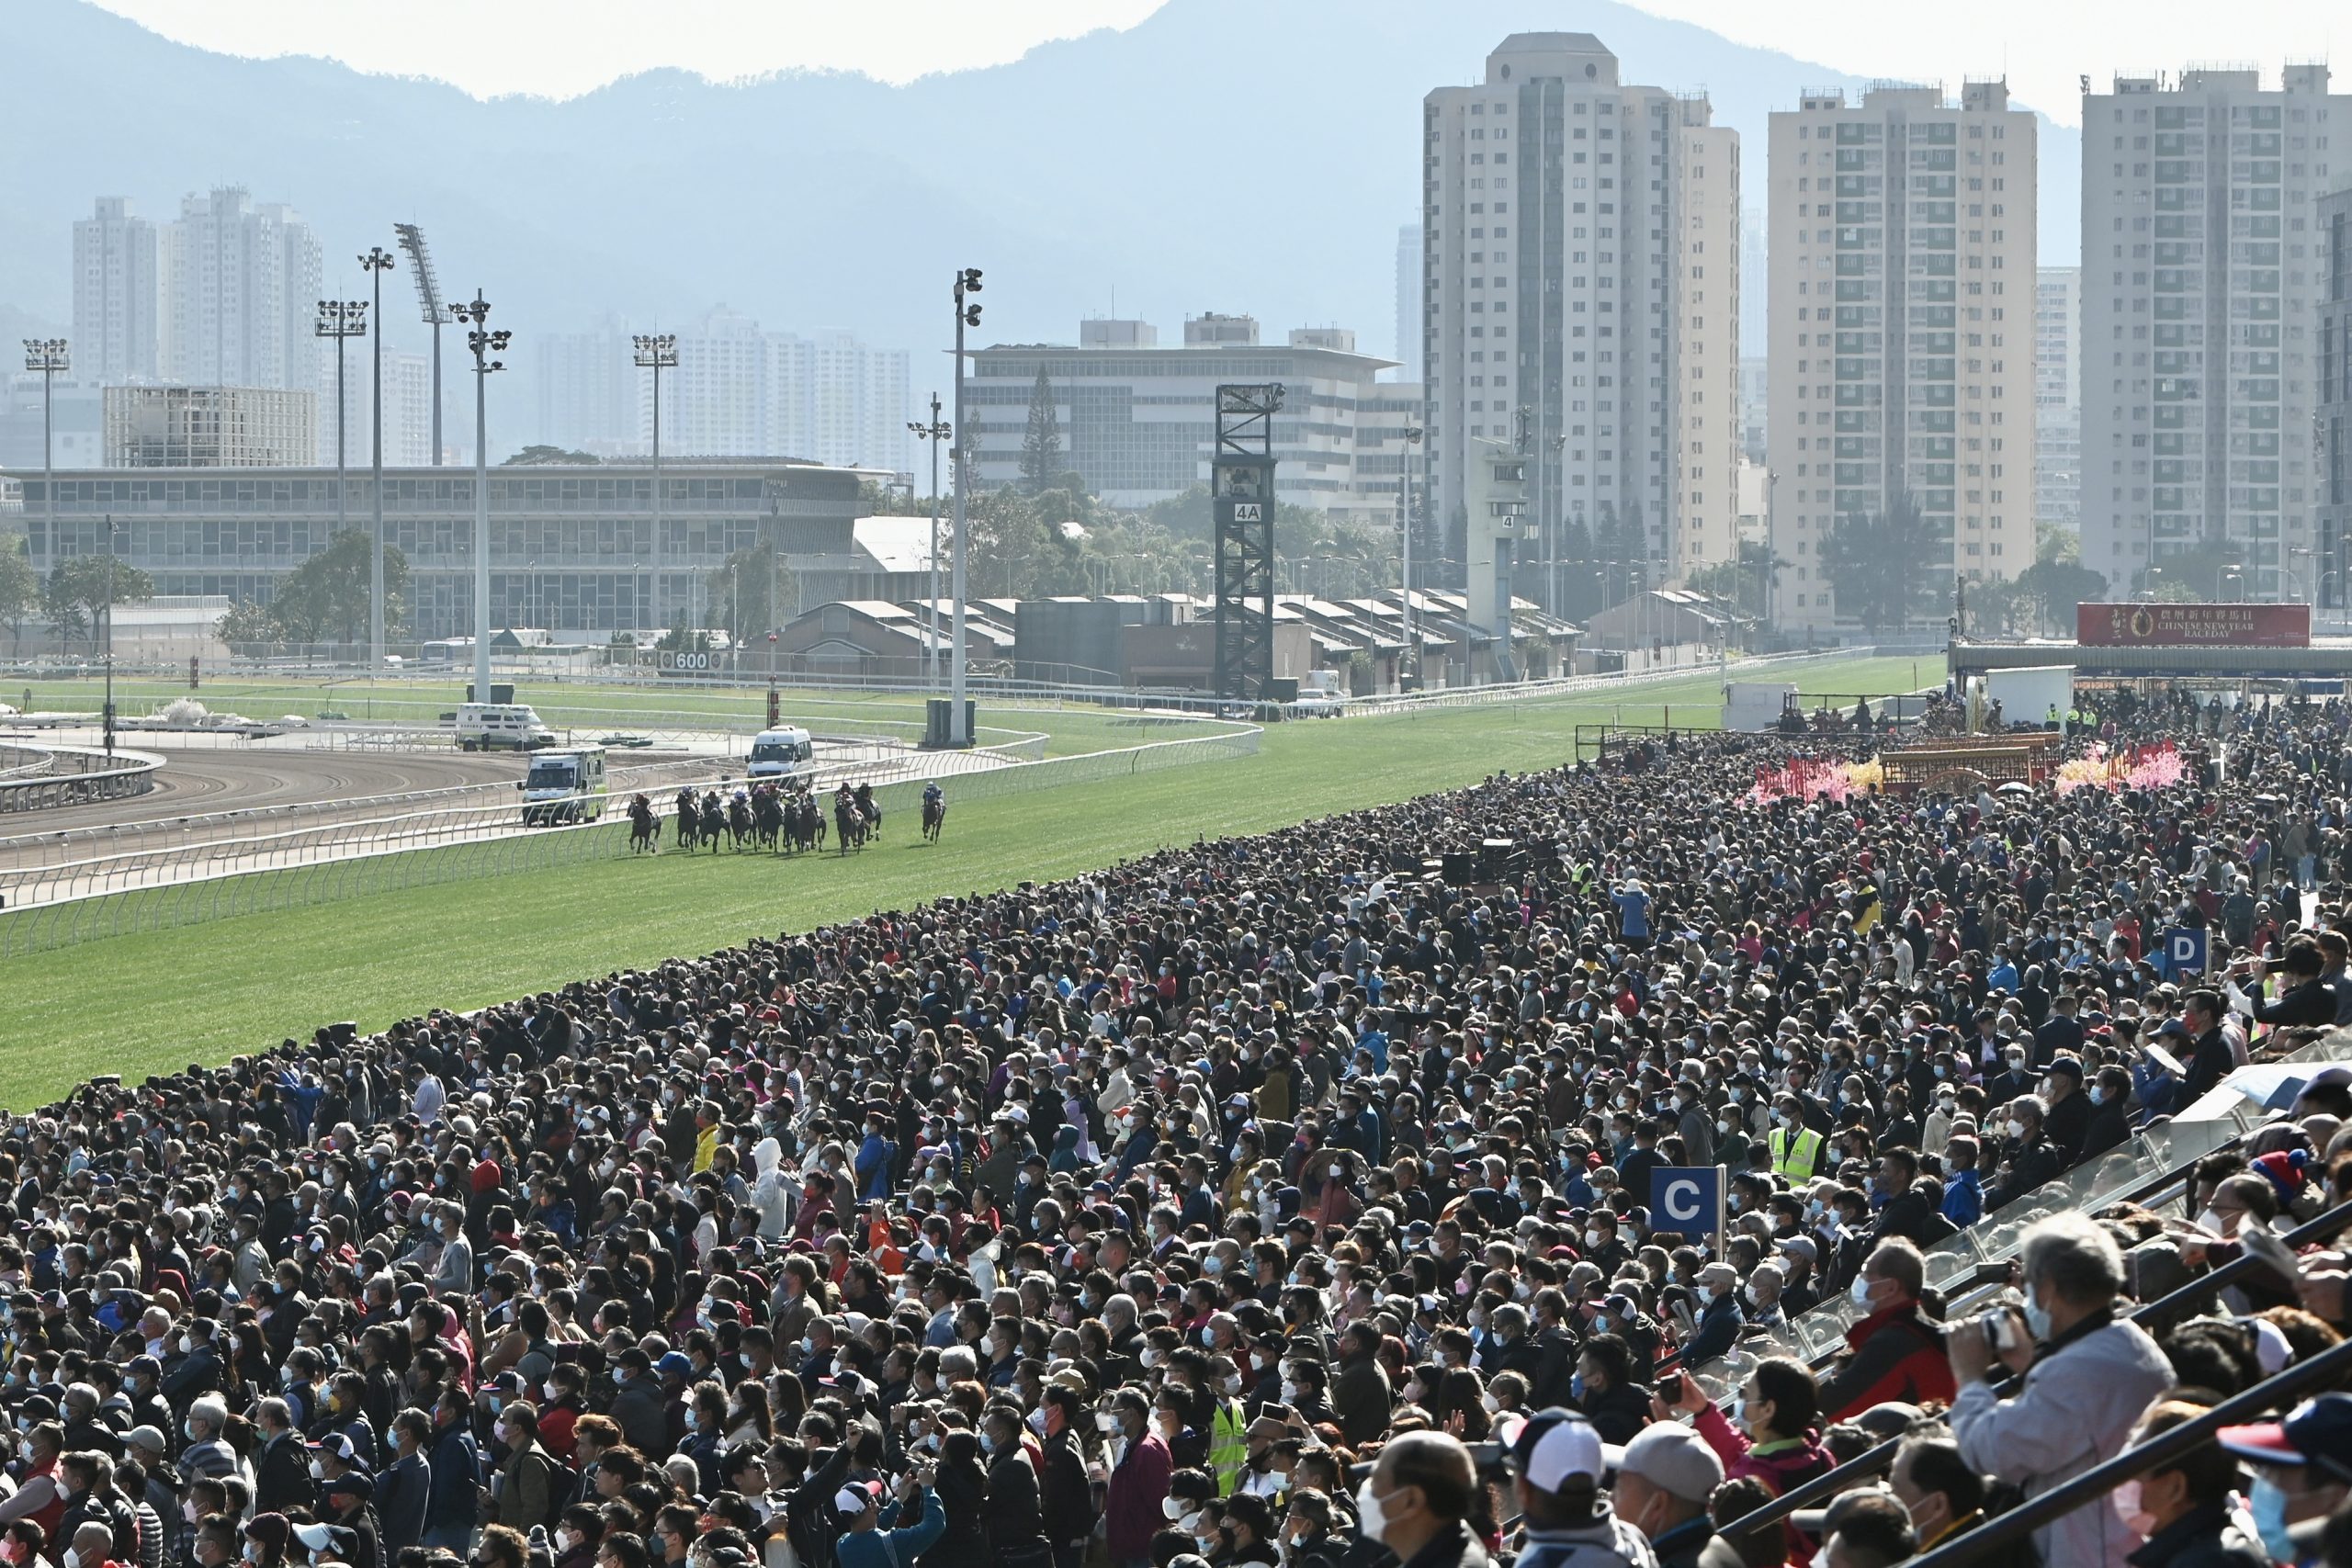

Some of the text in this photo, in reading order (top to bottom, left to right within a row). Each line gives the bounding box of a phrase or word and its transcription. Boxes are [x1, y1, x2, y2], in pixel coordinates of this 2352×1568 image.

[1237, 505, 1260, 519] 4A
[1504, 516, 1512, 527] 4
[2158, 622, 2254, 630] CHINESE NEW YEAR
[2184, 630, 2231, 638] RACEDAY
[676, 653, 707, 669] 600
[2174, 937, 2195, 961] D
[1664, 1179, 1701, 1220] C
